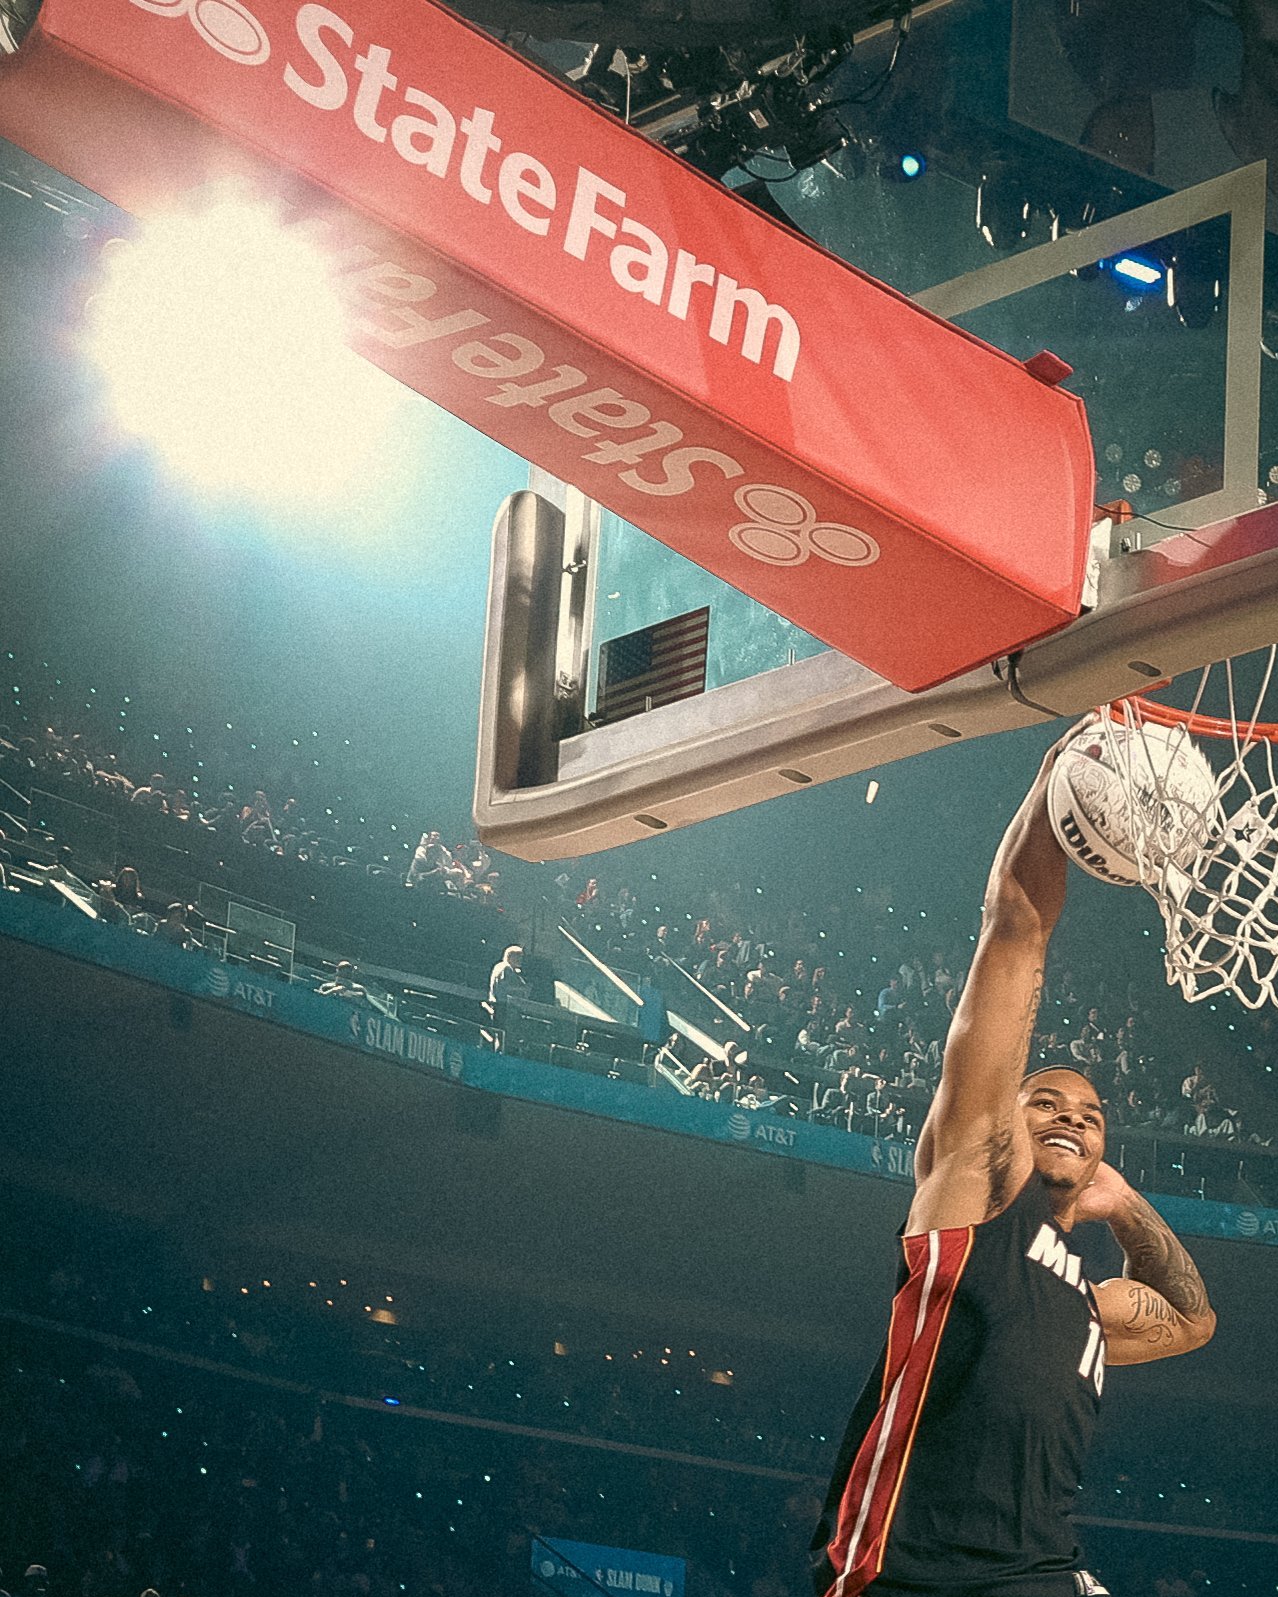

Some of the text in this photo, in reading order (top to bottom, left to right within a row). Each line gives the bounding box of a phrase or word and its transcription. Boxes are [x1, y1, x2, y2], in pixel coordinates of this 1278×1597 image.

[233, 980, 277, 1009] AT&T
[366, 1016, 446, 1071] SLAM DUNK
[755, 1124, 798, 1147] AT&T
[887, 1145, 915, 1178] SLA
[606, 1568, 661, 1595] SLAM DUNK
